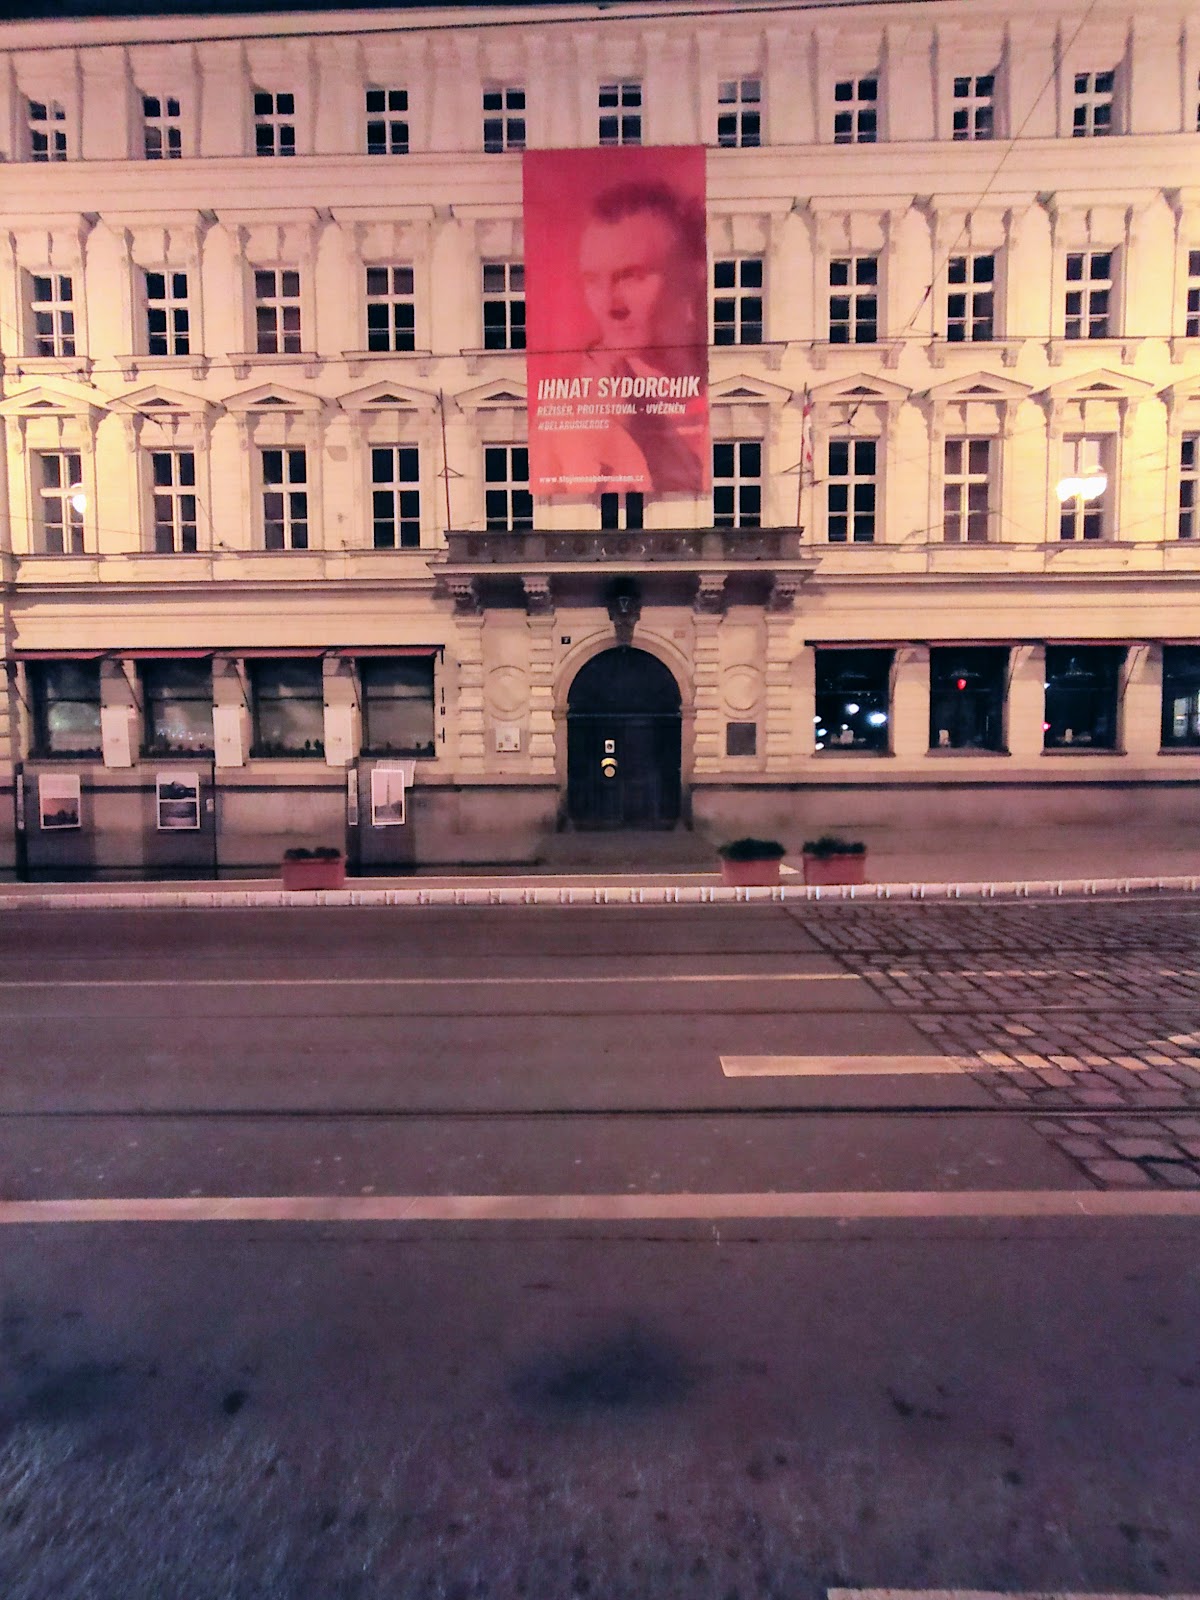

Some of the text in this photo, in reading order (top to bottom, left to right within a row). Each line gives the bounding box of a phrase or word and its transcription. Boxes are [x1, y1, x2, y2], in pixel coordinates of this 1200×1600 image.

[537, 375, 701, 401] IHNAT SYDORCHIK
[577, 403, 638, 416] PROTESTOVAL
